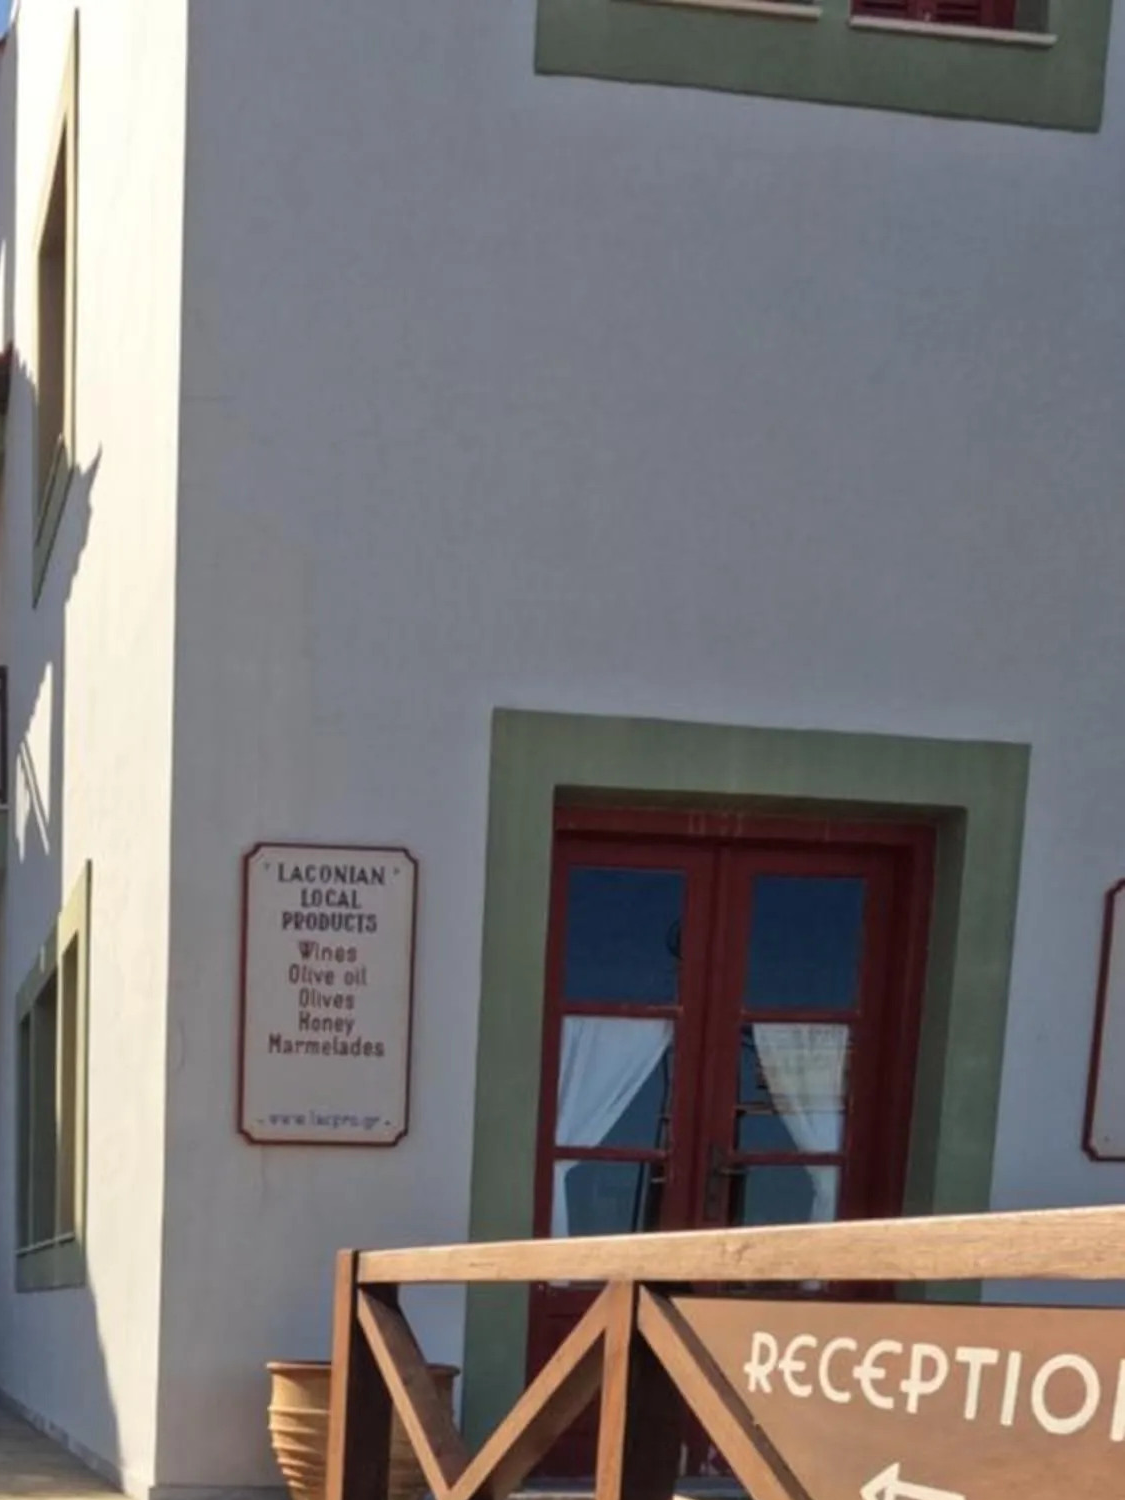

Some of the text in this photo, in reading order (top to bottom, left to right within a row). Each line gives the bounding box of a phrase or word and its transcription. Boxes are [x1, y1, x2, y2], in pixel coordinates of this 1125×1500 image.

[278, 862, 385, 885] LACONIAN
[300, 888, 361, 909] LOCAL
[282, 911, 377, 934] PRODUCTS
[298, 940, 357, 963] Wines
[289, 963, 367, 986] Olive oil
[299, 988, 355, 1010] Olives
[299, 1010, 355, 1035] Honey
[744, 1331, 1125, 1442] RECEPTIO
